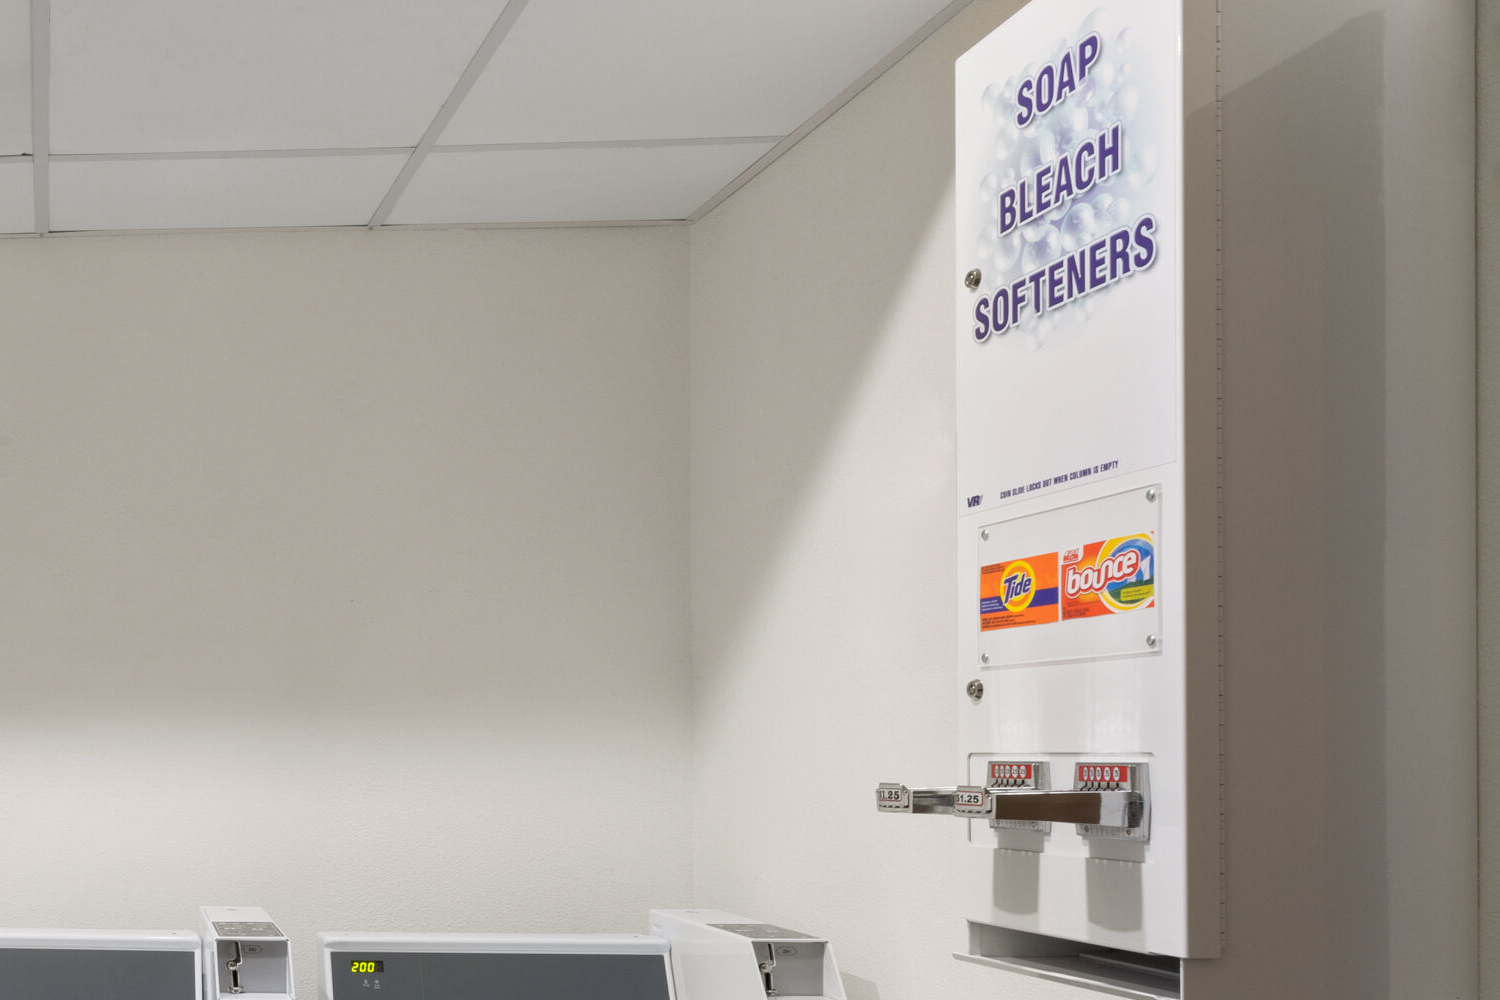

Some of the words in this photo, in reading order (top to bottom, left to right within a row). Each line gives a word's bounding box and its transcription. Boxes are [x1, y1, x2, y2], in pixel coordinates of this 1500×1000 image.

[1016, 34, 1099, 127] SOAP
[999, 125, 1120, 235] BLEACH
[974, 217, 1155, 340] SOFTENERS
[1026, 480, 1041, 492] LOCKS
[1042, 478, 1052, 488] OUT
[1053, 473, 1068, 485] WHEN
[1069, 467, 1092, 480] COLUMN
[1093, 465, 1099, 474] IS
[1100, 460, 1119, 472] EMPTY
[1003, 572, 1033, 606] Tide
[1065, 549, 1140, 598] bounce
[351, 961, 376, 973] 200
